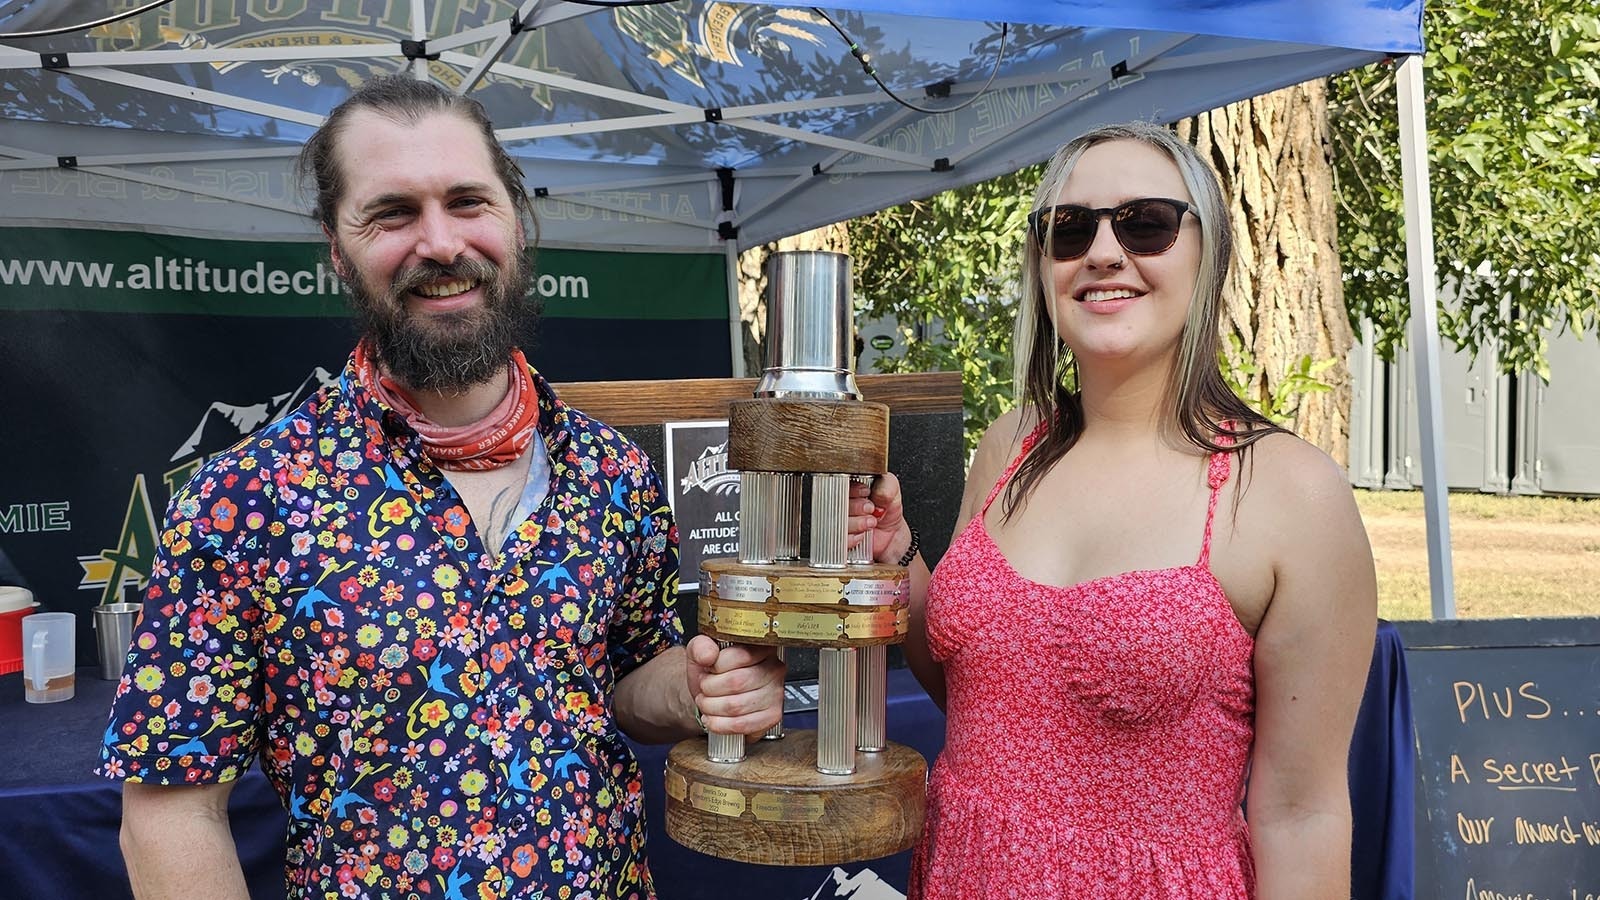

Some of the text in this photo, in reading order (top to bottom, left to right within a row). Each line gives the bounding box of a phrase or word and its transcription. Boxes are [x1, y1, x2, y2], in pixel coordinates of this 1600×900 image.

[505, 402, 527, 430] SNAKE
[479, 428, 508, 451] RIVER
[0, 501, 71, 533] MIE
[714, 511, 733, 523] ALL
[688, 526, 739, 540] ALTITUDE'
[702, 543, 721, 555] ARE
[1450, 754, 1470, 784] A
